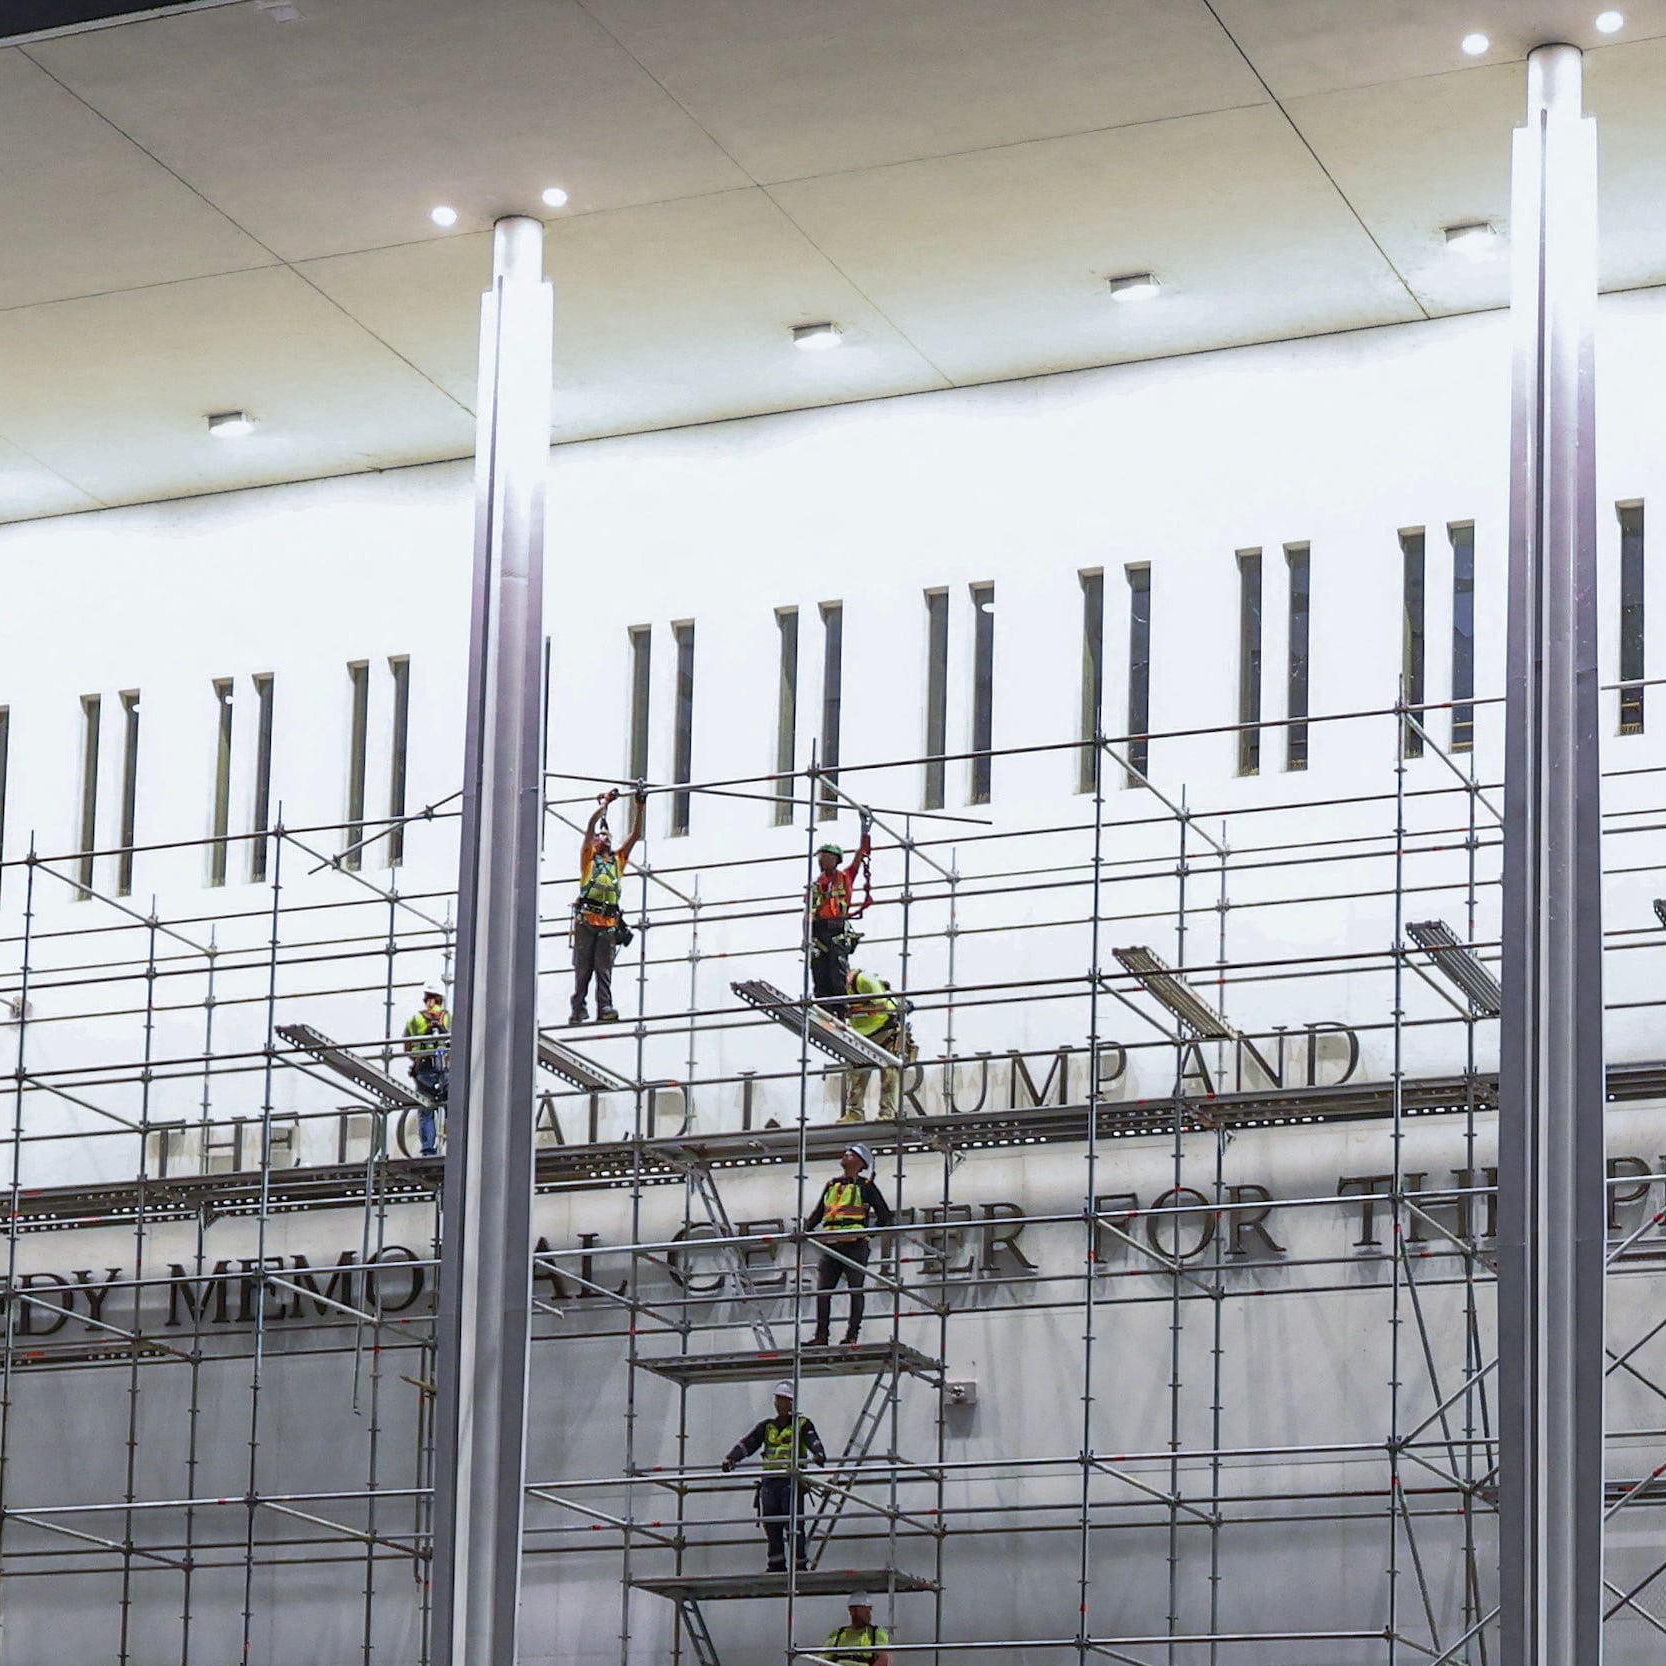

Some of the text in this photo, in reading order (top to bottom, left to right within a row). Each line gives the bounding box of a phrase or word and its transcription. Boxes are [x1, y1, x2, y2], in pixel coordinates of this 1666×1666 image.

[823, 1041, 1127, 1118] TRUMP
[1173, 1020, 1360, 1100] AND
[165, 1232, 628, 1328] MEMOAL
[667, 1201, 1038, 1292] CETER
[1089, 1183, 1287, 1264] FOR
